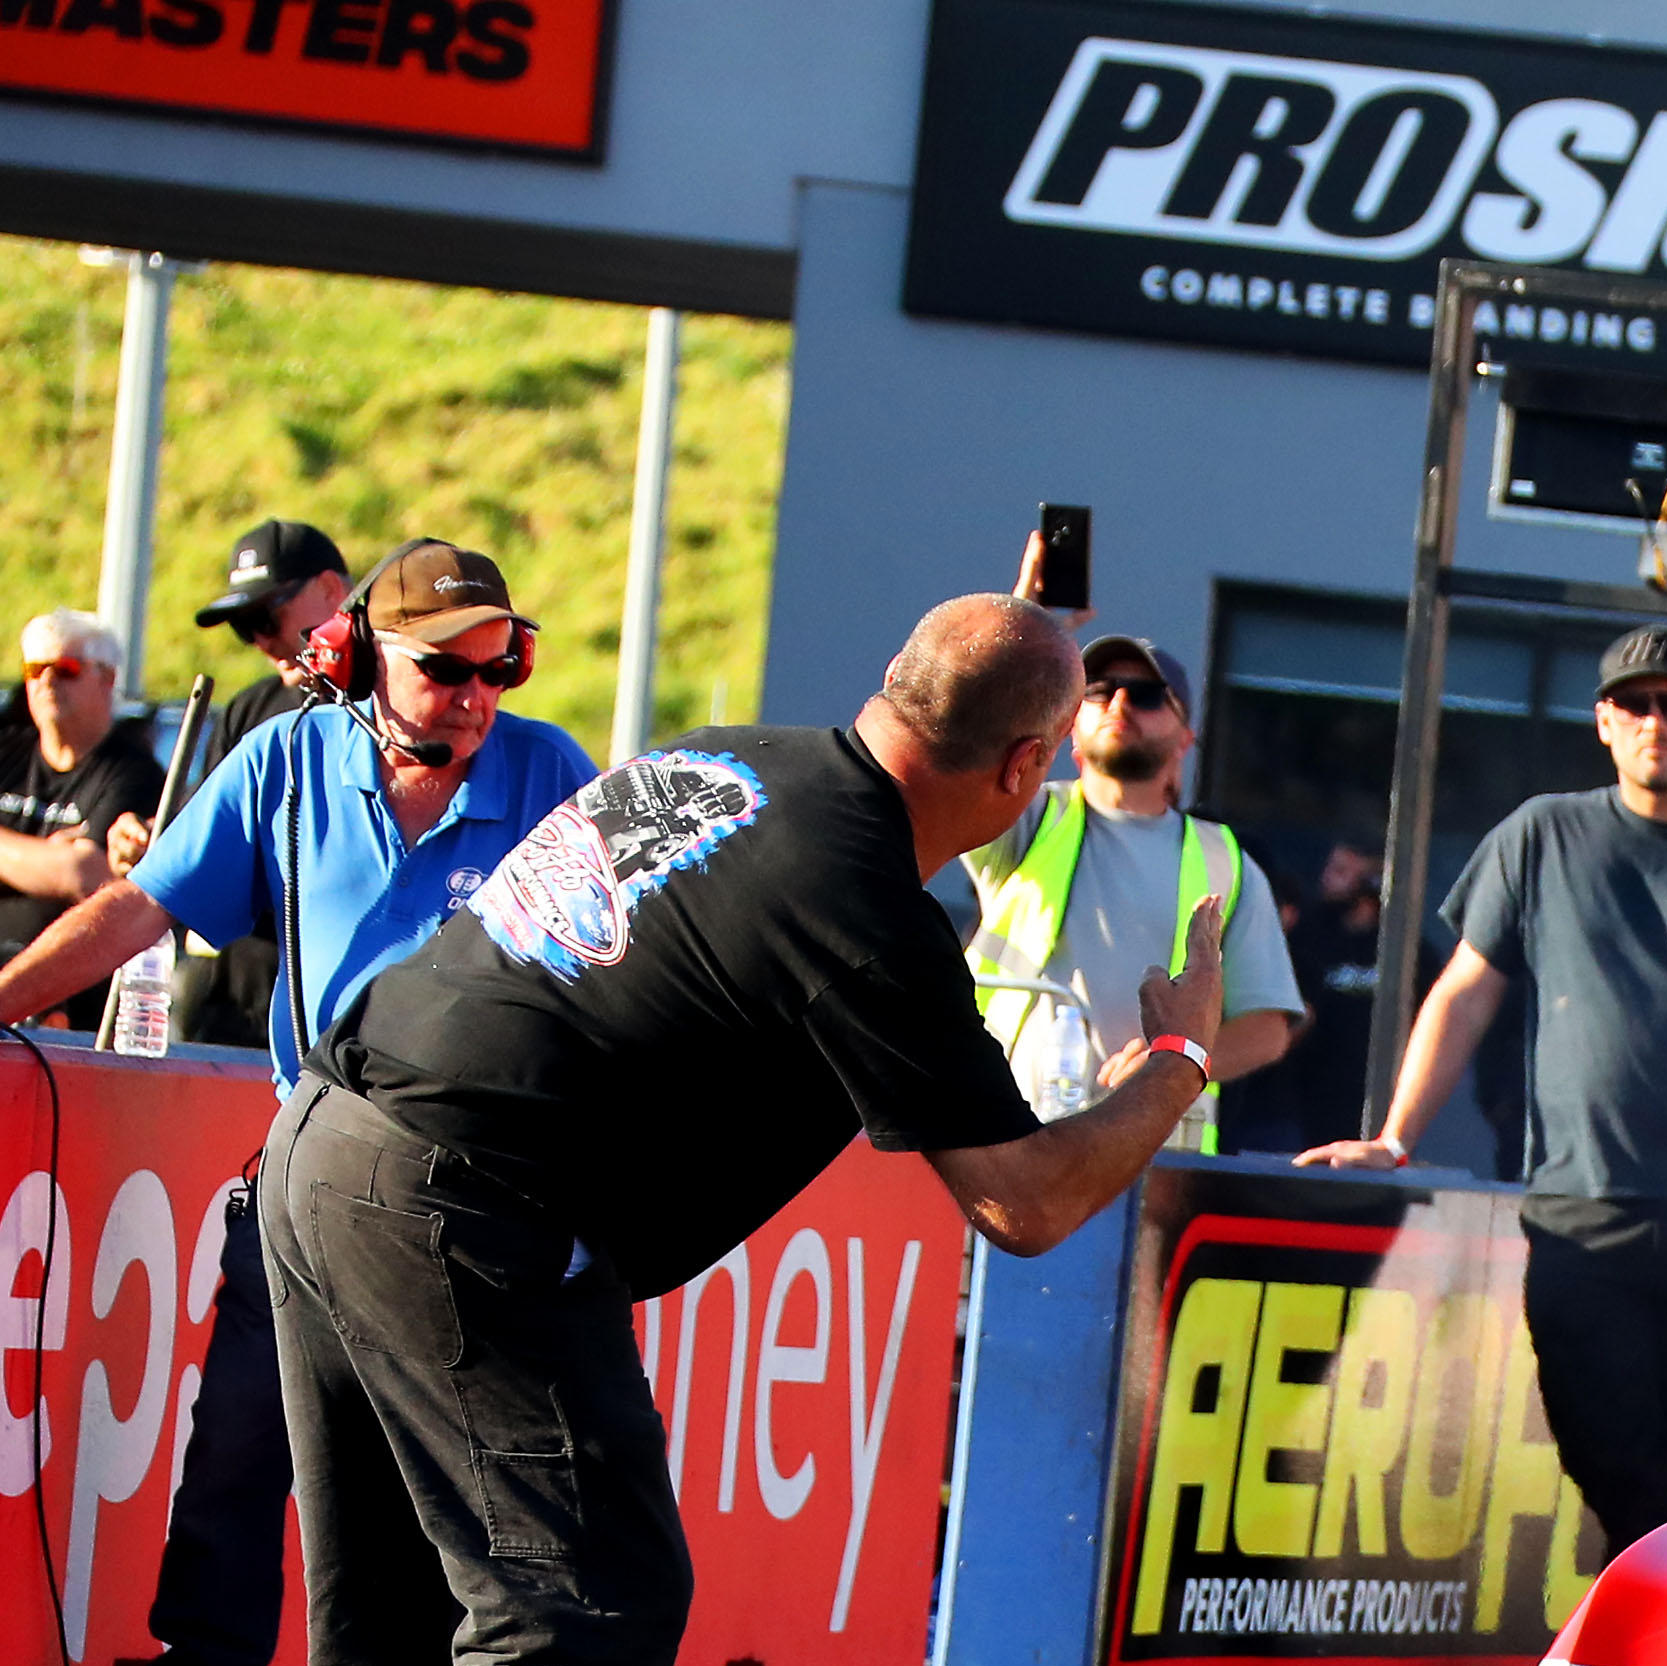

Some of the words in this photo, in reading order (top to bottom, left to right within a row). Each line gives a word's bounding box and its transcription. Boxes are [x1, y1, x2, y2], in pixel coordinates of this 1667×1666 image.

[1141, 264, 1390, 325] COMPLETE
[1409, 294, 1656, 353] BANDING
[1178, 1577, 1350, 1634] PERFORMANCE
[1349, 1579, 1468, 1634] PRODUCTS
